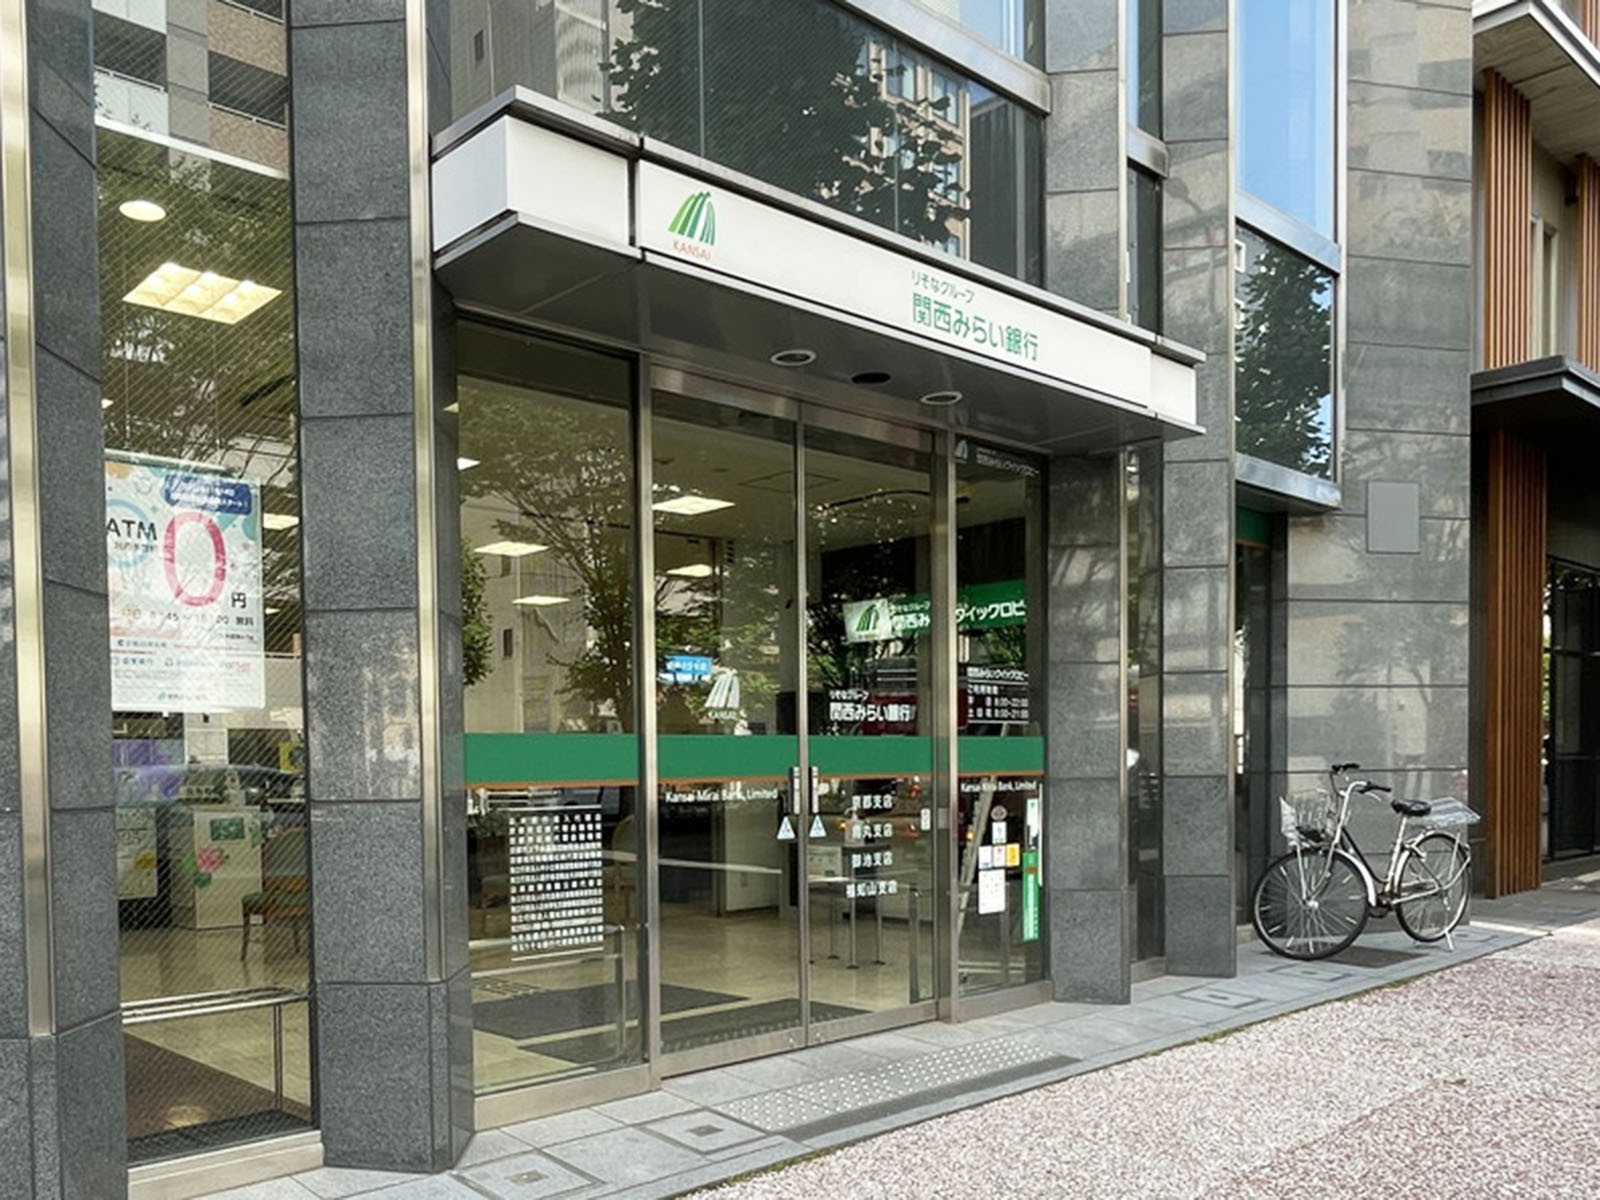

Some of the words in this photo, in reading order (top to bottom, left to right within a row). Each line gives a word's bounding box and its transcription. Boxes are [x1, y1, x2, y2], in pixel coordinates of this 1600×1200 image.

[672, 241, 712, 260] KANSAI
[912, 269, 975, 303] りそなグループ
[912, 292, 1038, 361] 関西みらい銀行
[105, 518, 157, 541] ATM
[230, 592, 247, 609] 円
[829, 701, 912, 722] 関西みらい銀行
